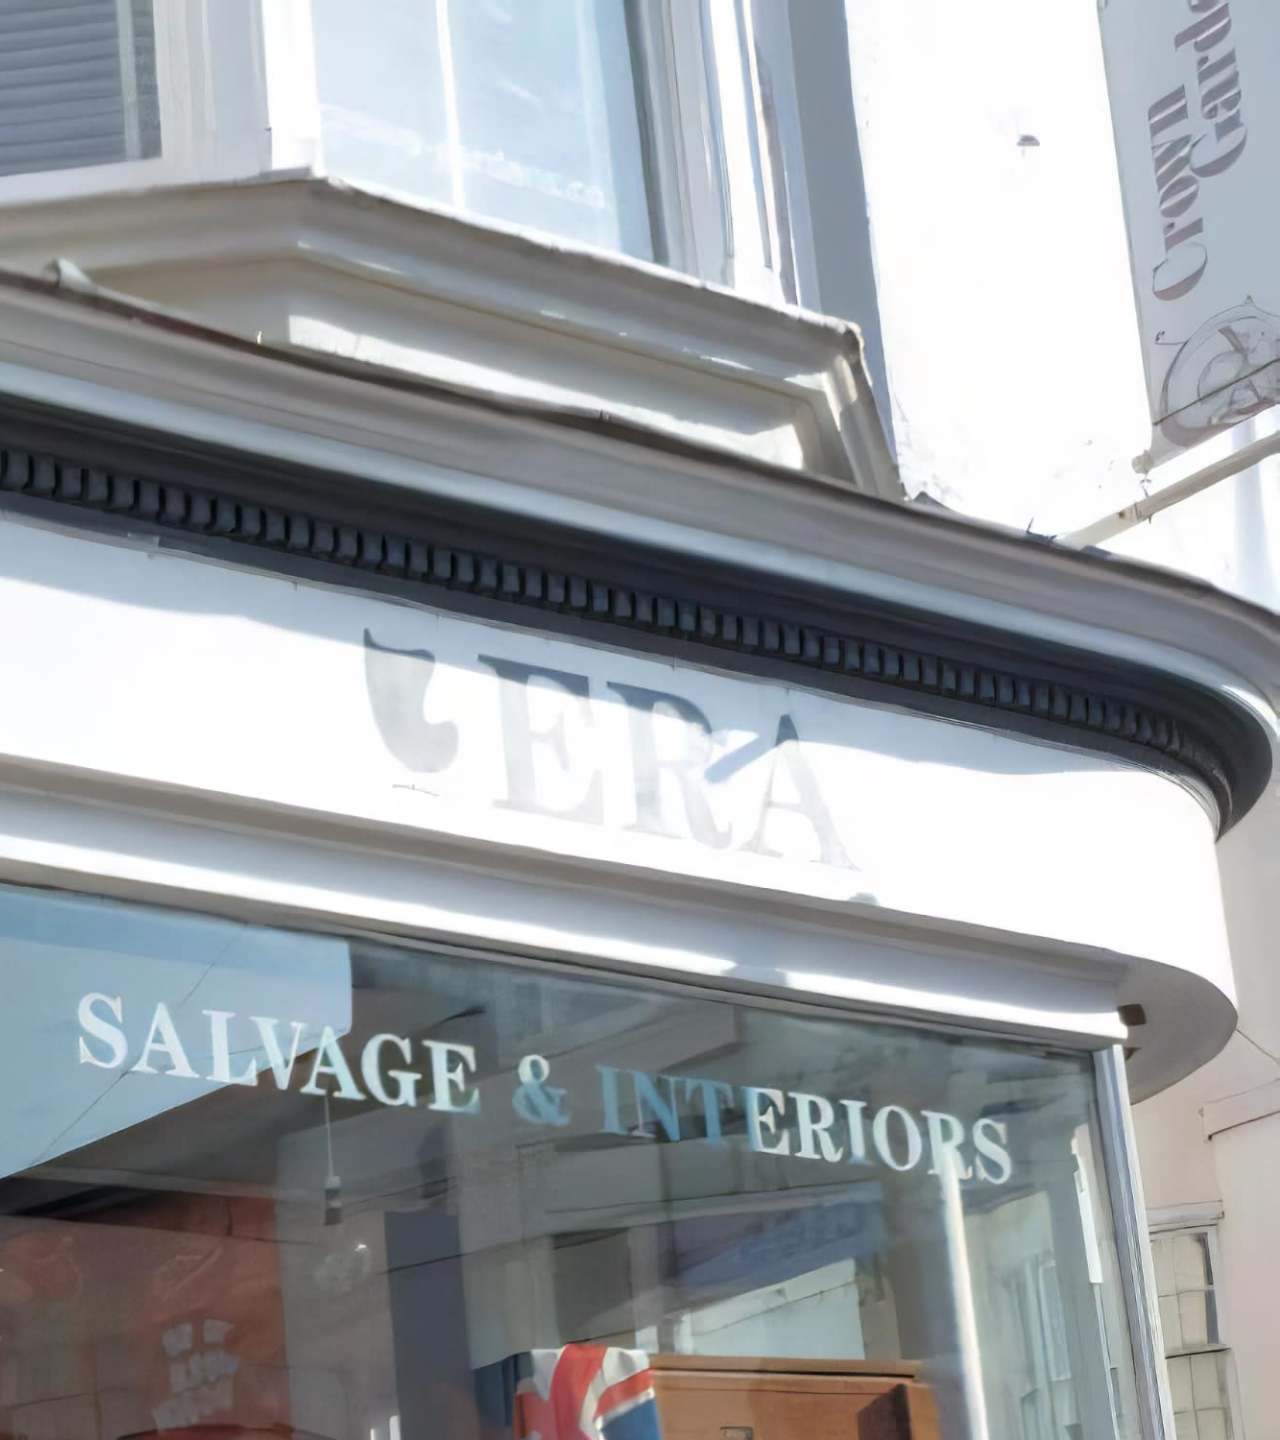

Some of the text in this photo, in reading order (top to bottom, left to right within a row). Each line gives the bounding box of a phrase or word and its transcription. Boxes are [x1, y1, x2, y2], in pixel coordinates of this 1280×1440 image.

[1147, 84, 1208, 300] Crown
[478, 653, 861, 873] ERA
[77, 992, 1013, 1185] SALVAGE & INTERIORS
